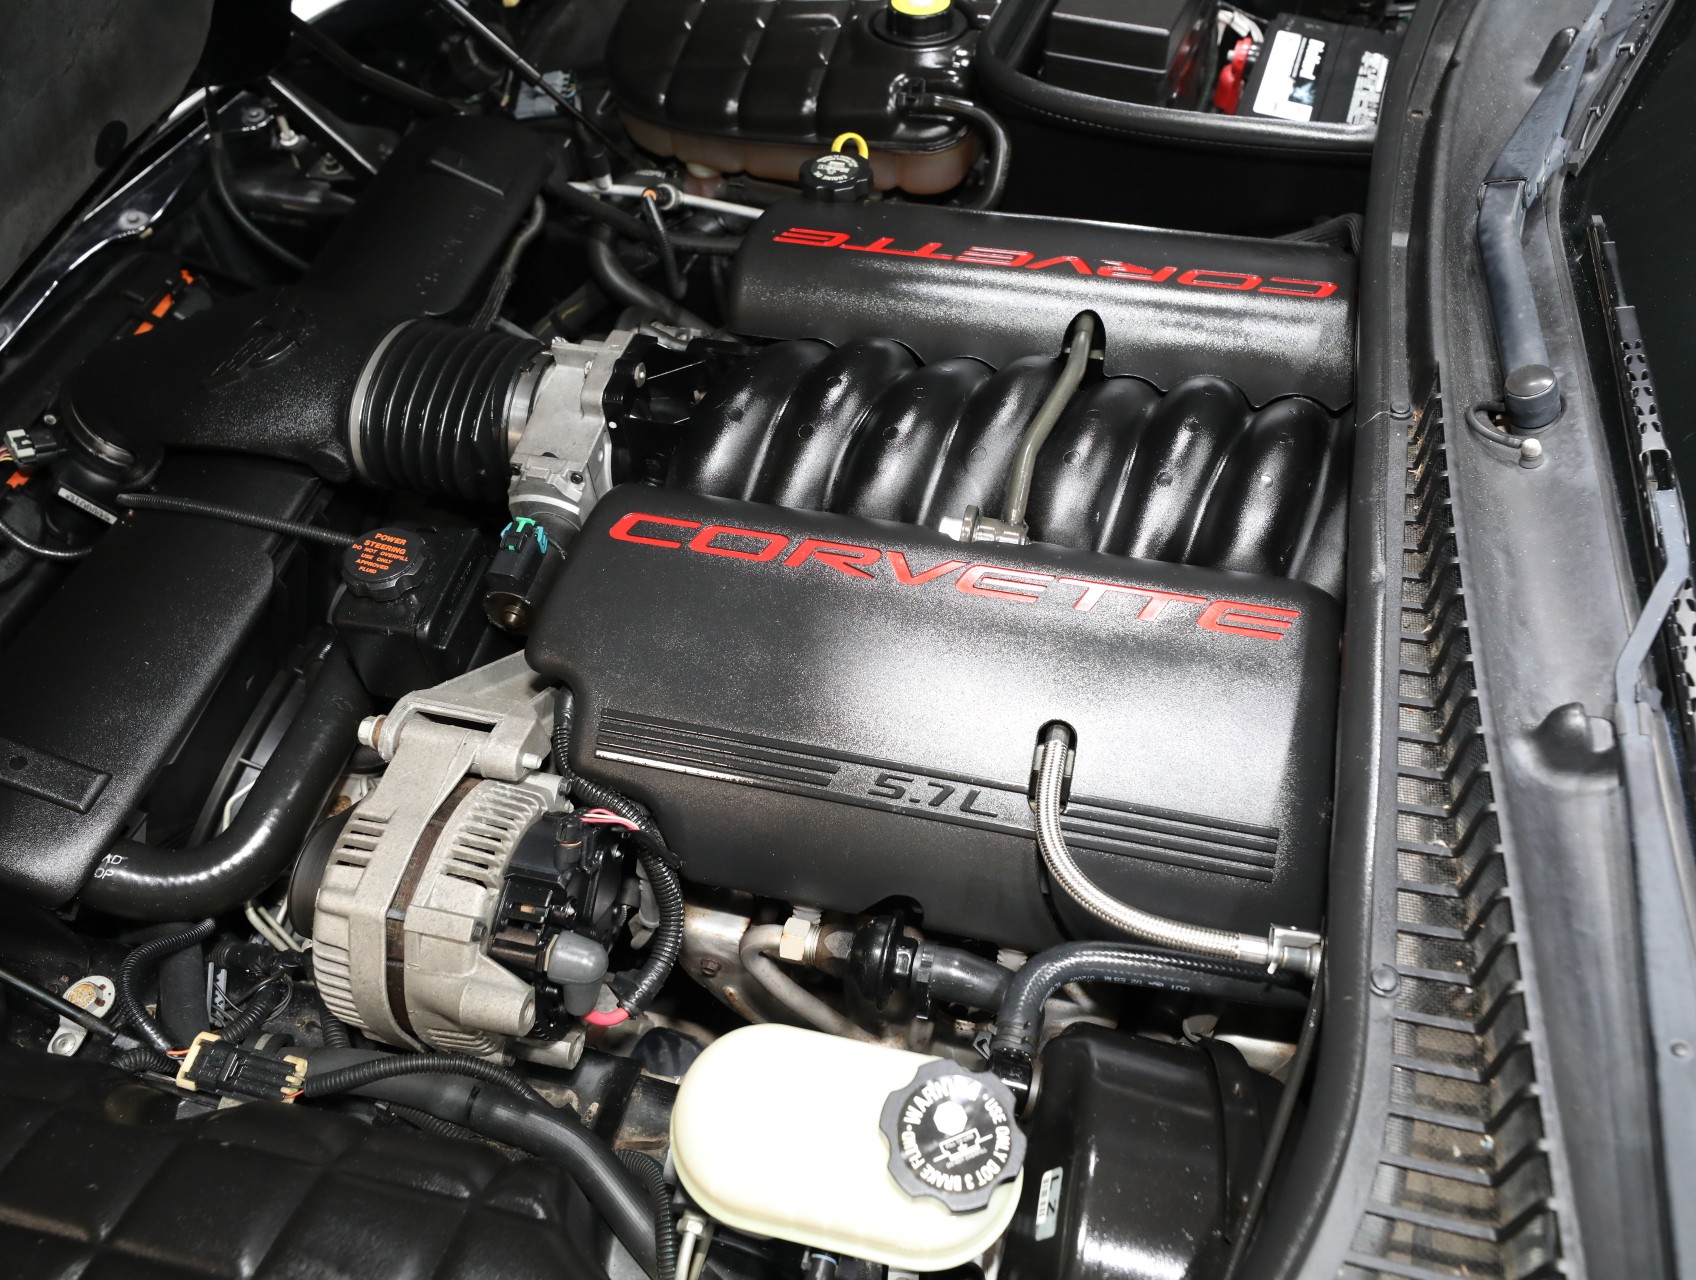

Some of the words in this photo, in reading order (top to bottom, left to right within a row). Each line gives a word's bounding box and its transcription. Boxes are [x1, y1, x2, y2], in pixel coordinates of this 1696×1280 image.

[772, 227, 1339, 298] CORVETTE
[364, 540, 406, 554] STEERING
[375, 533, 406, 545] POWER
[356, 559, 389, 570] APPROVED
[358, 566, 377, 574] FLUID
[380, 551, 408, 561] OVERFILL
[609, 511, 1301, 641] CORVETTE
[868, 772, 998, 817] 5.7L
[903, 1075, 983, 1125] WARN
[984, 1097, 1007, 1125] USE
[902, 1130, 925, 1170] FLUID
[993, 1126, 1010, 1163] ONLY
[920, 1163, 962, 1192] BRAKE
[964, 1173, 975, 1190] 3
[975, 1158, 1001, 1186] DOT
